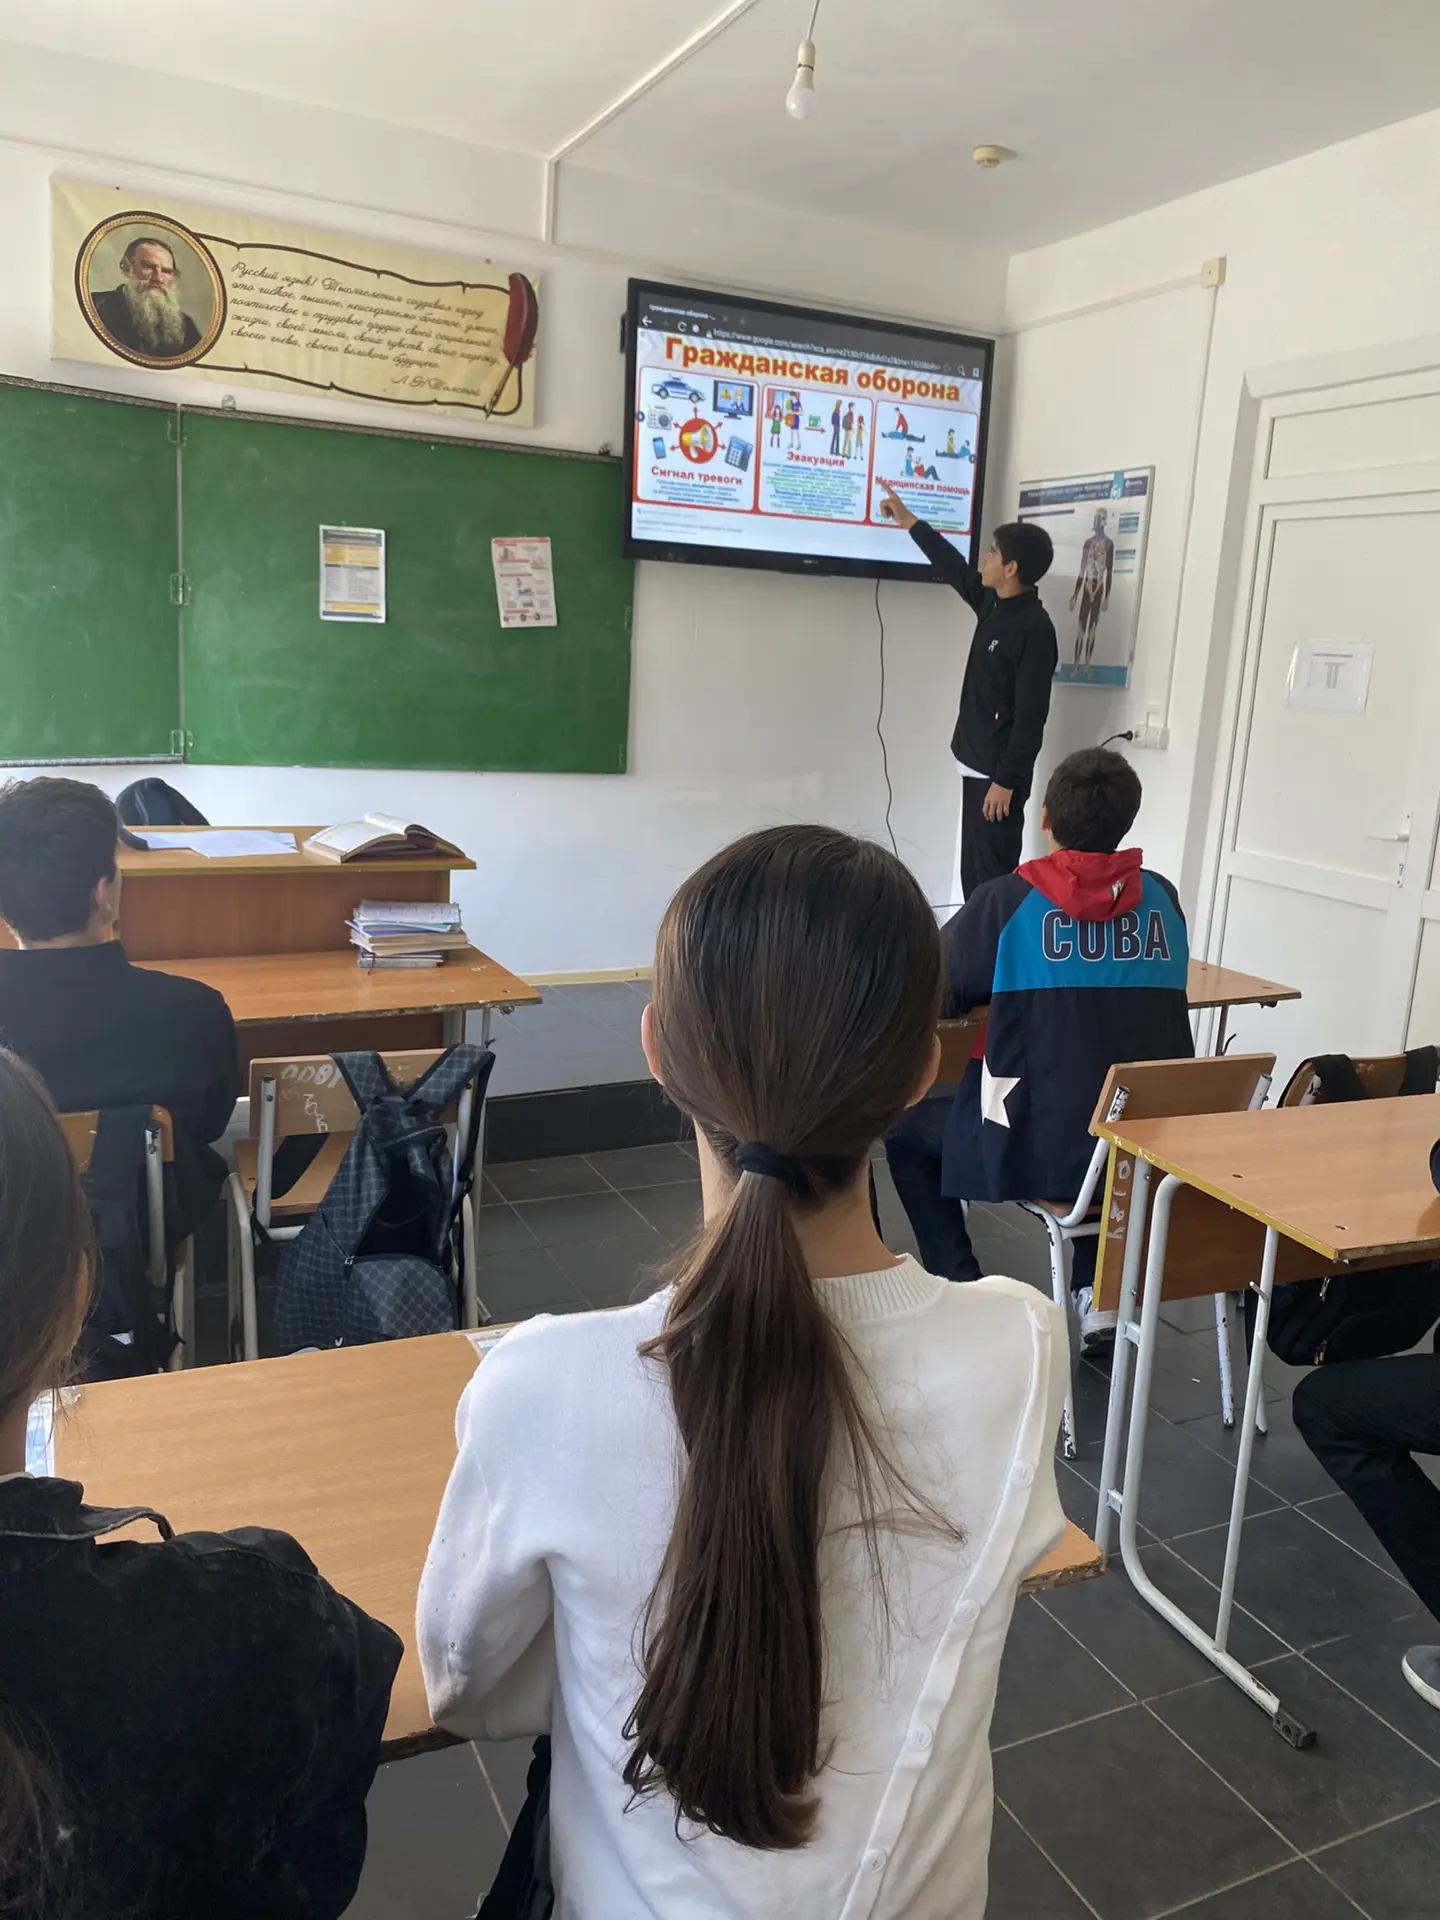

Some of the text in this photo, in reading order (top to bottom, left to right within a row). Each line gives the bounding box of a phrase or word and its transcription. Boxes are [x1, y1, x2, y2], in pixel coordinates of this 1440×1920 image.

[231, 262, 280, 280] Русский
[664, 335, 961, 401] Гражданская оборона
[786, 451, 845, 467] Эвакуация
[651, 466, 743, 486] Сигнал тревоги
[936, 483, 971, 496] помощь
[1042, 909, 1171, 961] CUBA
